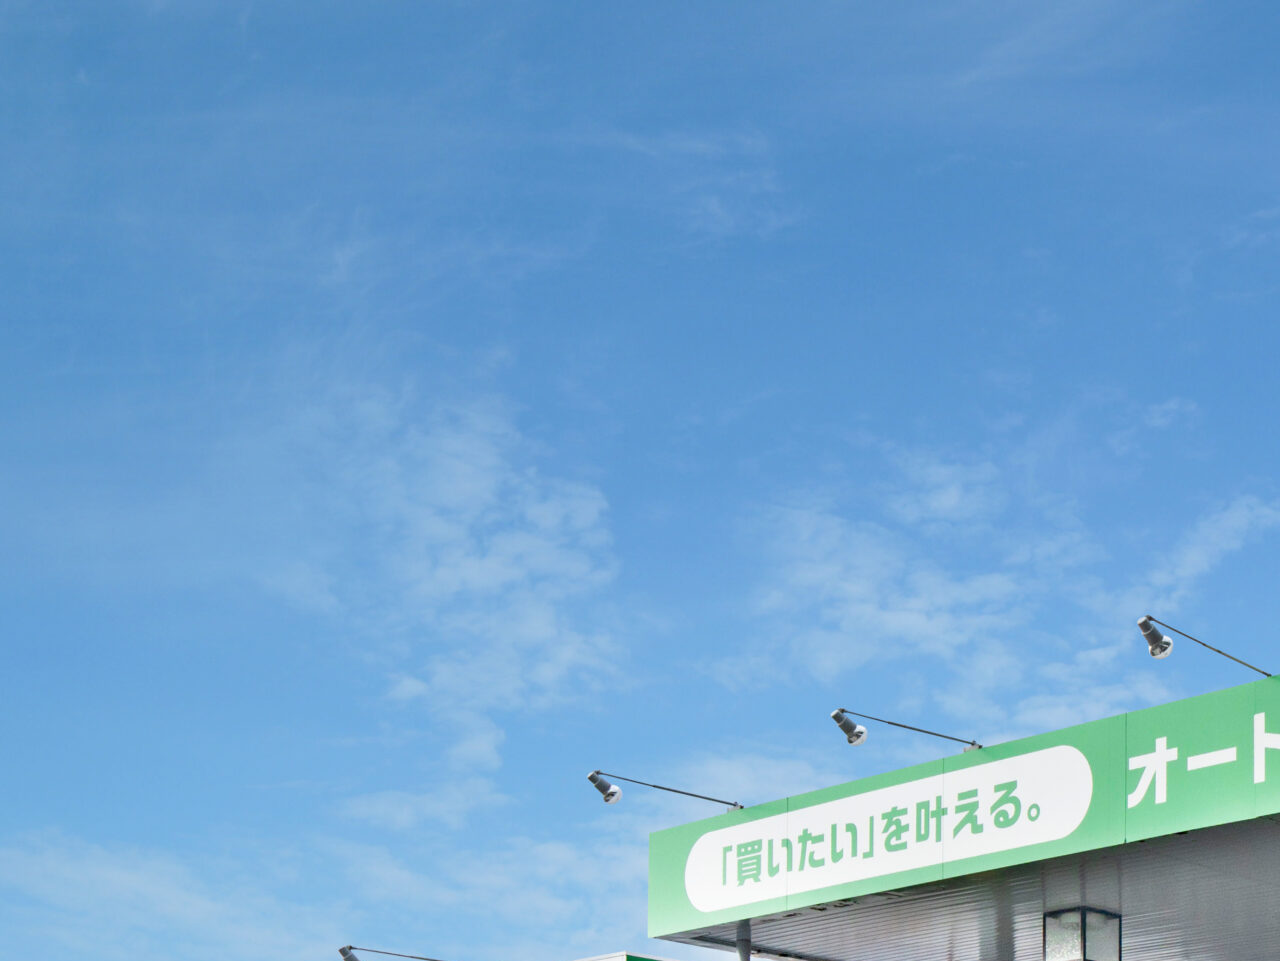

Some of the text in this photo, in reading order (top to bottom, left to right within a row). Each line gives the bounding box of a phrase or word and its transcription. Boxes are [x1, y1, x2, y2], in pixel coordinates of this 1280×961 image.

[721, 779, 1041, 887] 「買いたい」を叶える。
